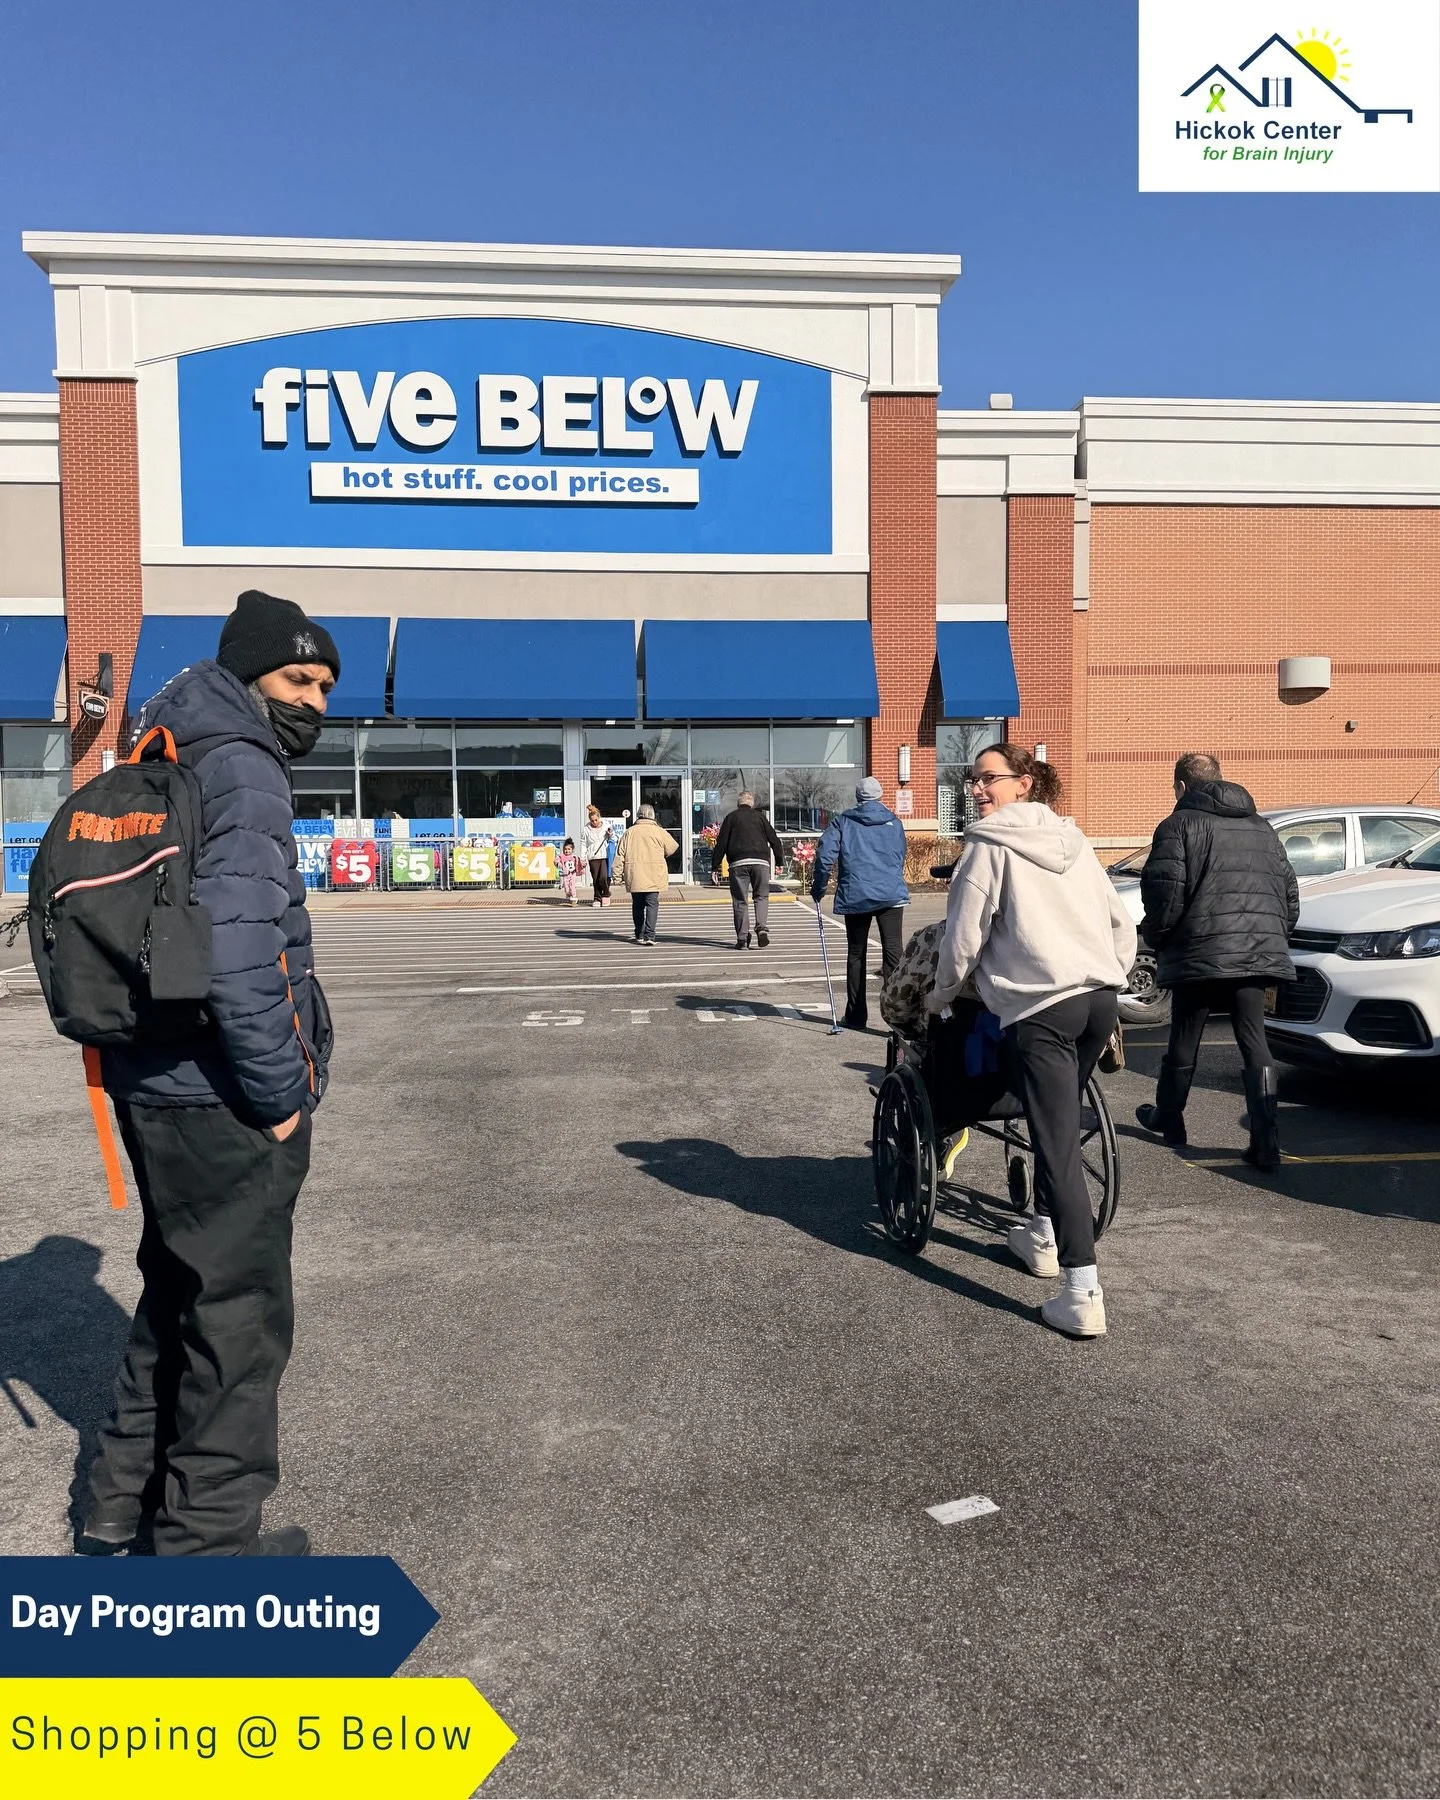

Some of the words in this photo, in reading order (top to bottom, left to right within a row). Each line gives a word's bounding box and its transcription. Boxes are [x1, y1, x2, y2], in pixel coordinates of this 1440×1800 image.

[254, 367, 457, 447] five
[478, 374, 760, 453] BELOW
[343, 466, 393, 489] hot
[403, 467, 483, 491] stuff.
[493, 470, 558, 492] cool
[568, 471, 670, 497] prices.
[67, 811, 168, 843] FORTNITE
[336, 854, 372, 883] $5
[396, 852, 431, 882] $5
[457, 852, 491, 882] $5
[518, 851, 551, 880] $4
[521, 1002, 833, 1027] STOP
